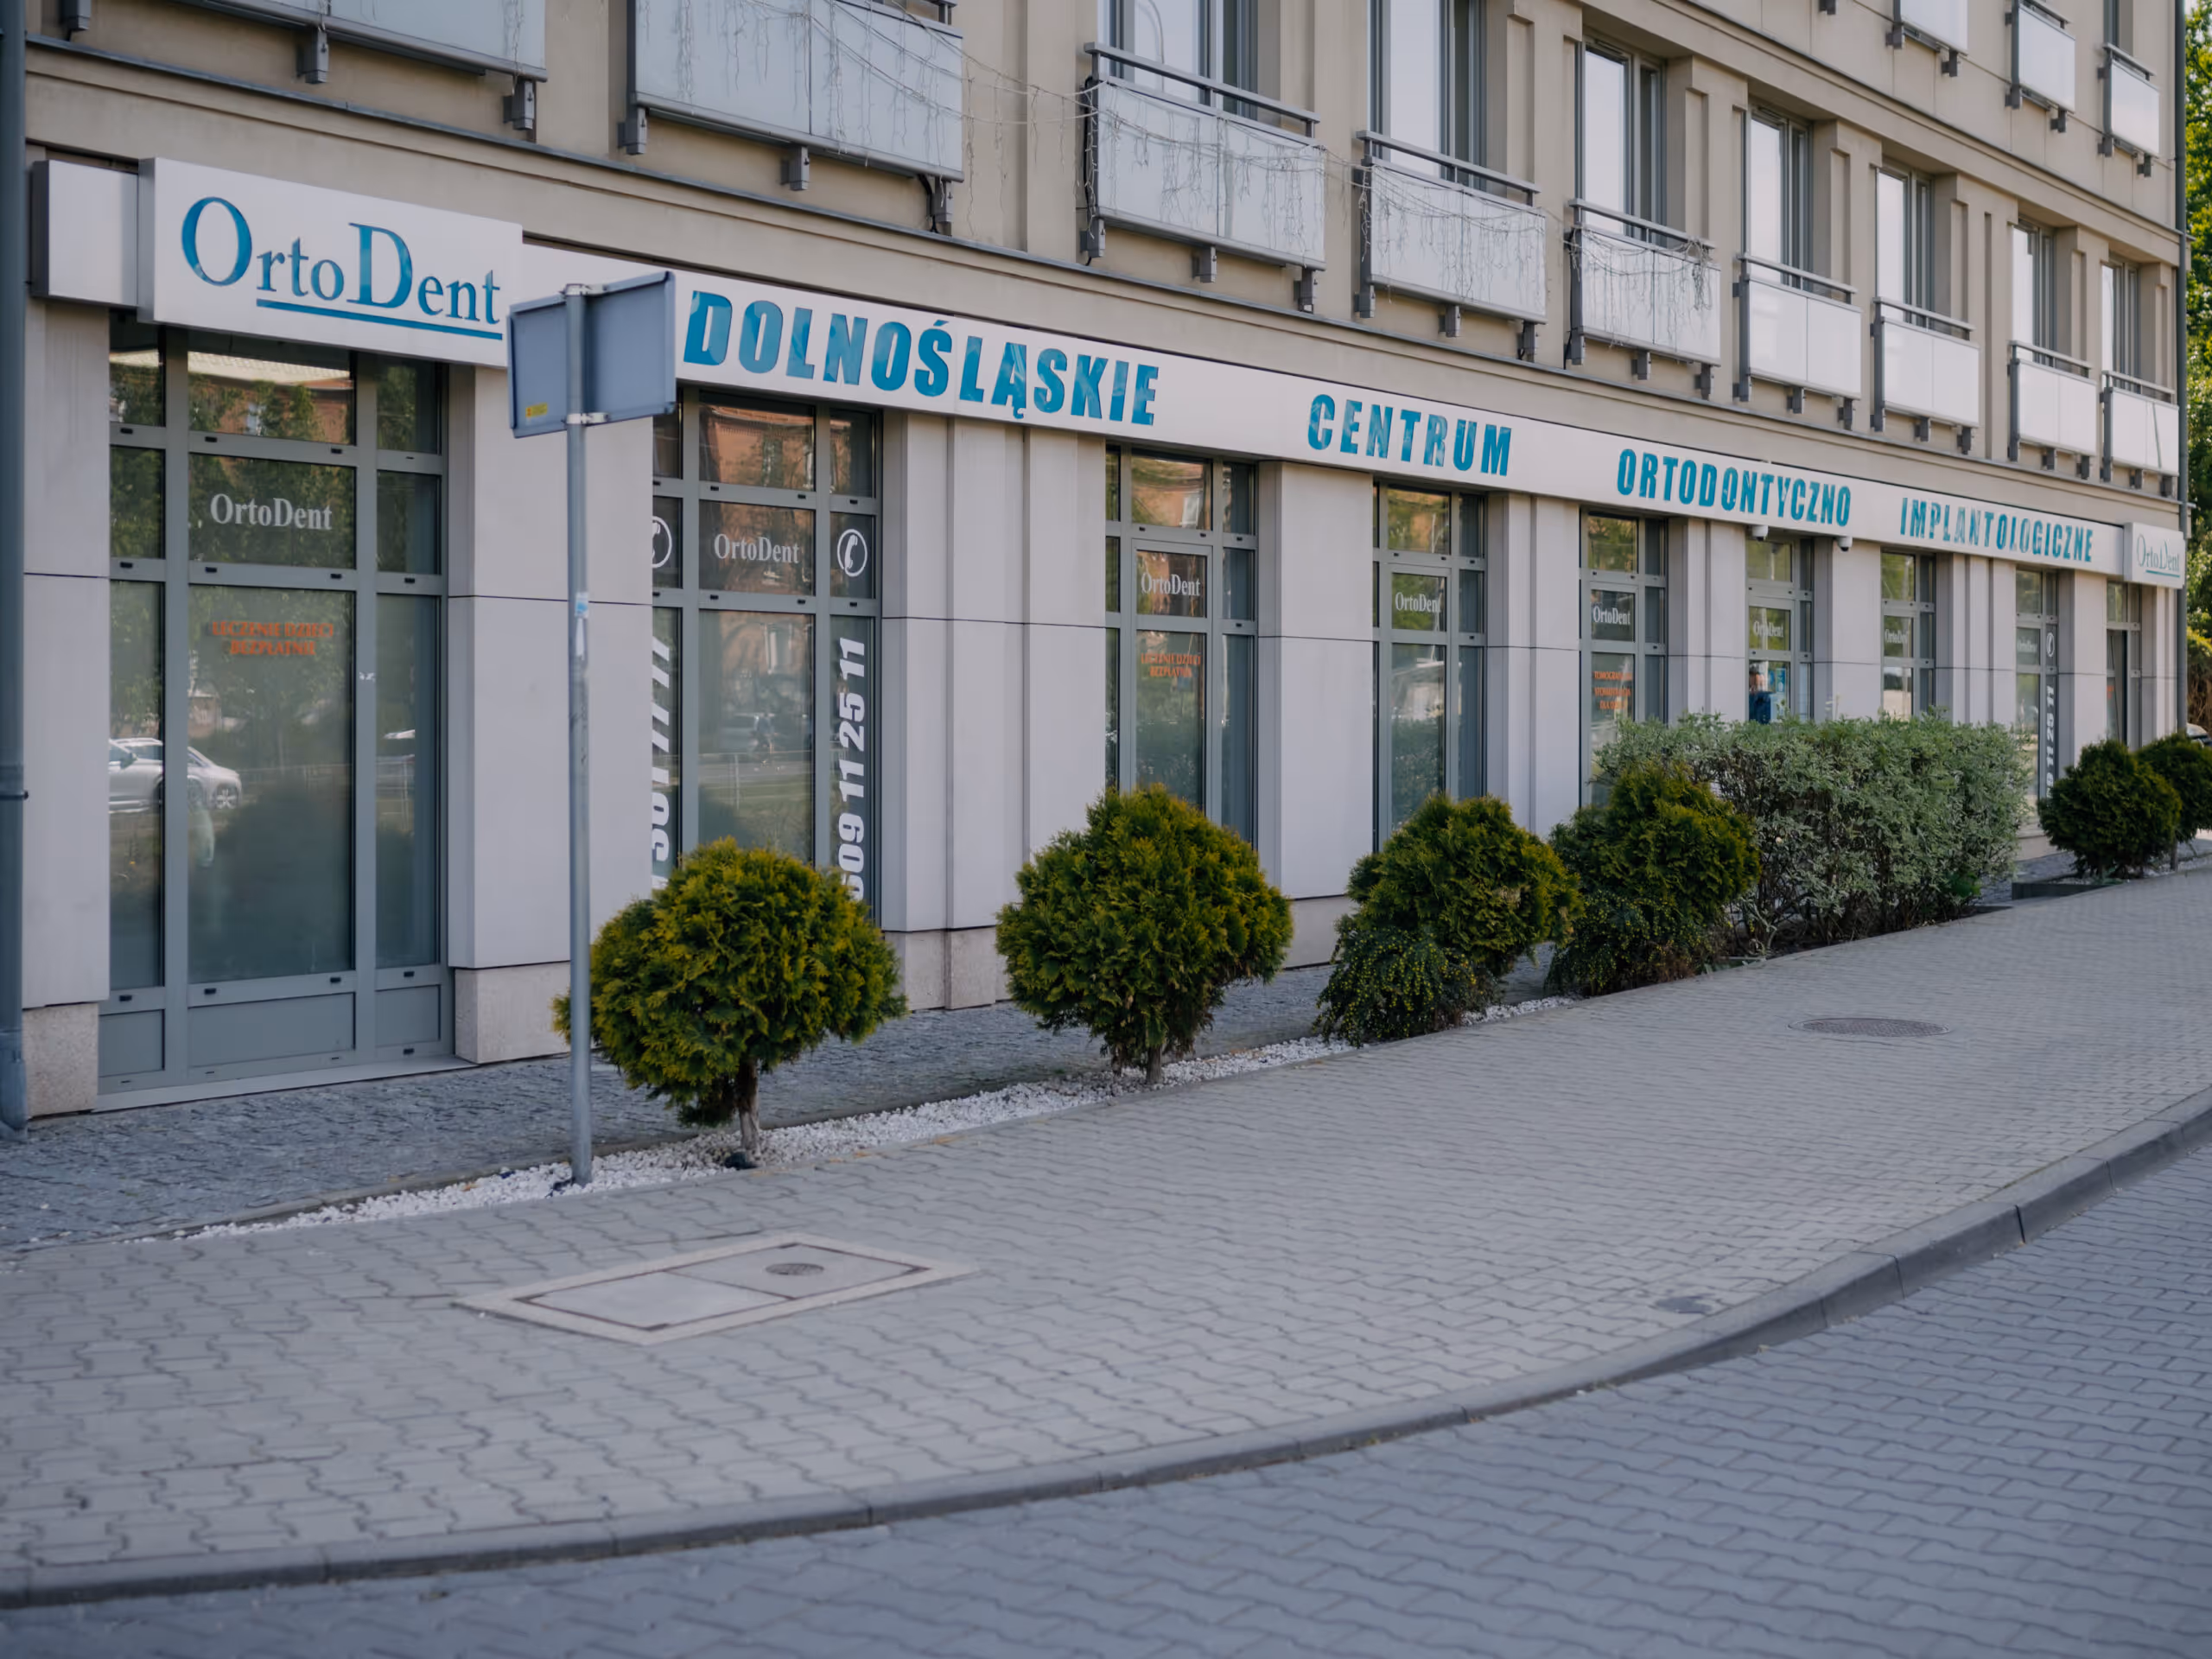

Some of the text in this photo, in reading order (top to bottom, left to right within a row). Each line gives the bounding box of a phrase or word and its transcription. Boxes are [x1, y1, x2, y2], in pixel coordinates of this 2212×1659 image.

[181, 196, 501, 325] OrtoDent
[683, 290, 2094, 563] DOLNOŚLĄSKIE CENTRUM ORTODONTYCZNO IMPLANTOLOGICZNE
[210, 493, 333, 530] OrtoDent
[714, 533, 801, 563] OrtoDent
[2137, 534, 2180, 572] OrtoDent
[1141, 572, 1201, 596] OrtoDent
[213, 621, 334, 637] LECZENIE DZIECI
[1593, 606, 1630, 625] OrtoDent
[838, 637, 866, 681] 11
[838, 692, 866, 753] 25
[838, 759, 866, 804] 11
